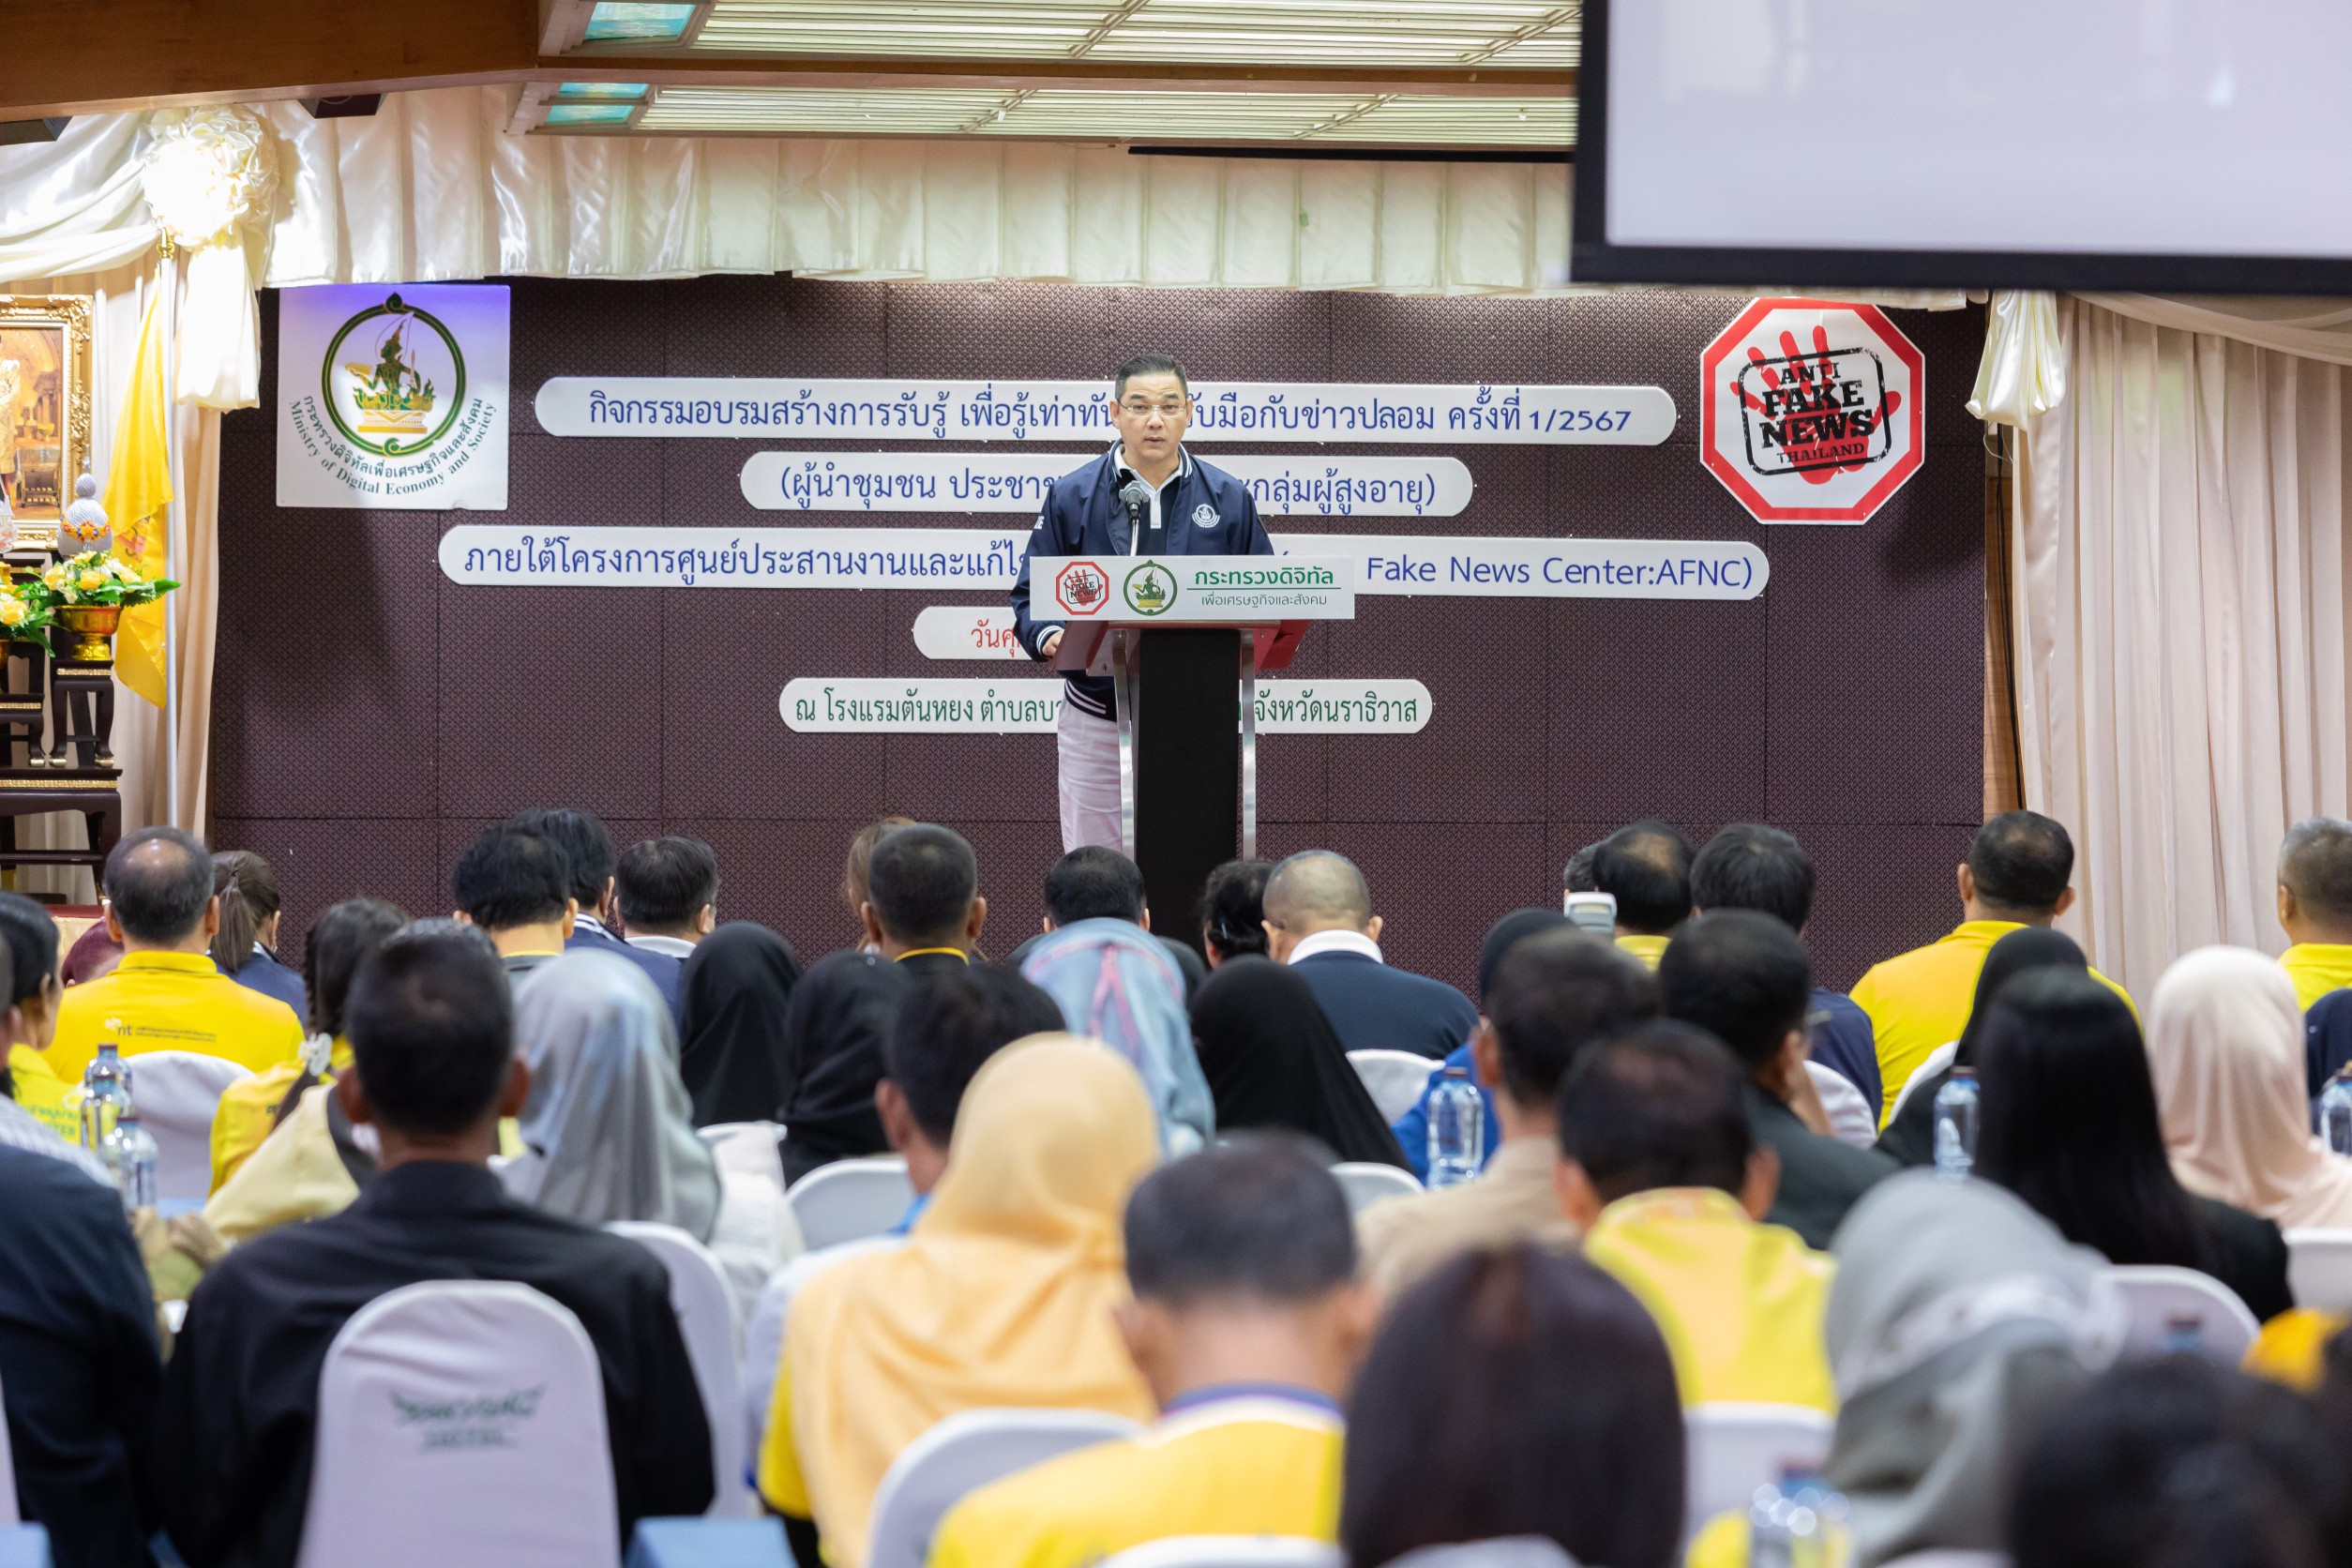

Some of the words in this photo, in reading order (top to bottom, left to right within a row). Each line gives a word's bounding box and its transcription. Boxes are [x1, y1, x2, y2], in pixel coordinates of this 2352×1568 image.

[1781, 362, 1842, 385] ANTI
[589, 389, 950, 439] กิจกรรมอบรมสร้างการรับรู้
[1529, 409, 1632, 432] 1/2567
[1761, 380, 1865, 417] FAKE
[1758, 409, 1875, 448] NEWS
[289, 400, 320, 457] Ministry
[321, 459, 337, 472] of
[336, 468, 380, 493] Digital
[385, 472, 445, 495] Economy
[447, 450, 470, 475] and
[467, 403, 497, 451] Society
[1776, 443, 1865, 463] THAILAND
[780, 461, 936, 509] (ผู้นำชุมชน
[463, 535, 1026, 586] ภายใต้โครงการศูนย์ประสานงานและแก้ไ
[1367, 553, 1437, 582] Fake
[1450, 557, 1530, 584] News
[1543, 556, 1754, 591] Center:AFNC)
[1195, 565, 1334, 585] กระทรวงดิจิทัล
[1201, 591, 1327, 609] เพื่อเศรษฐกิจและสังคม
[796, 699, 816, 721] ณ
[1254, 688, 1417, 721] จังหวัดนราธิวาส
